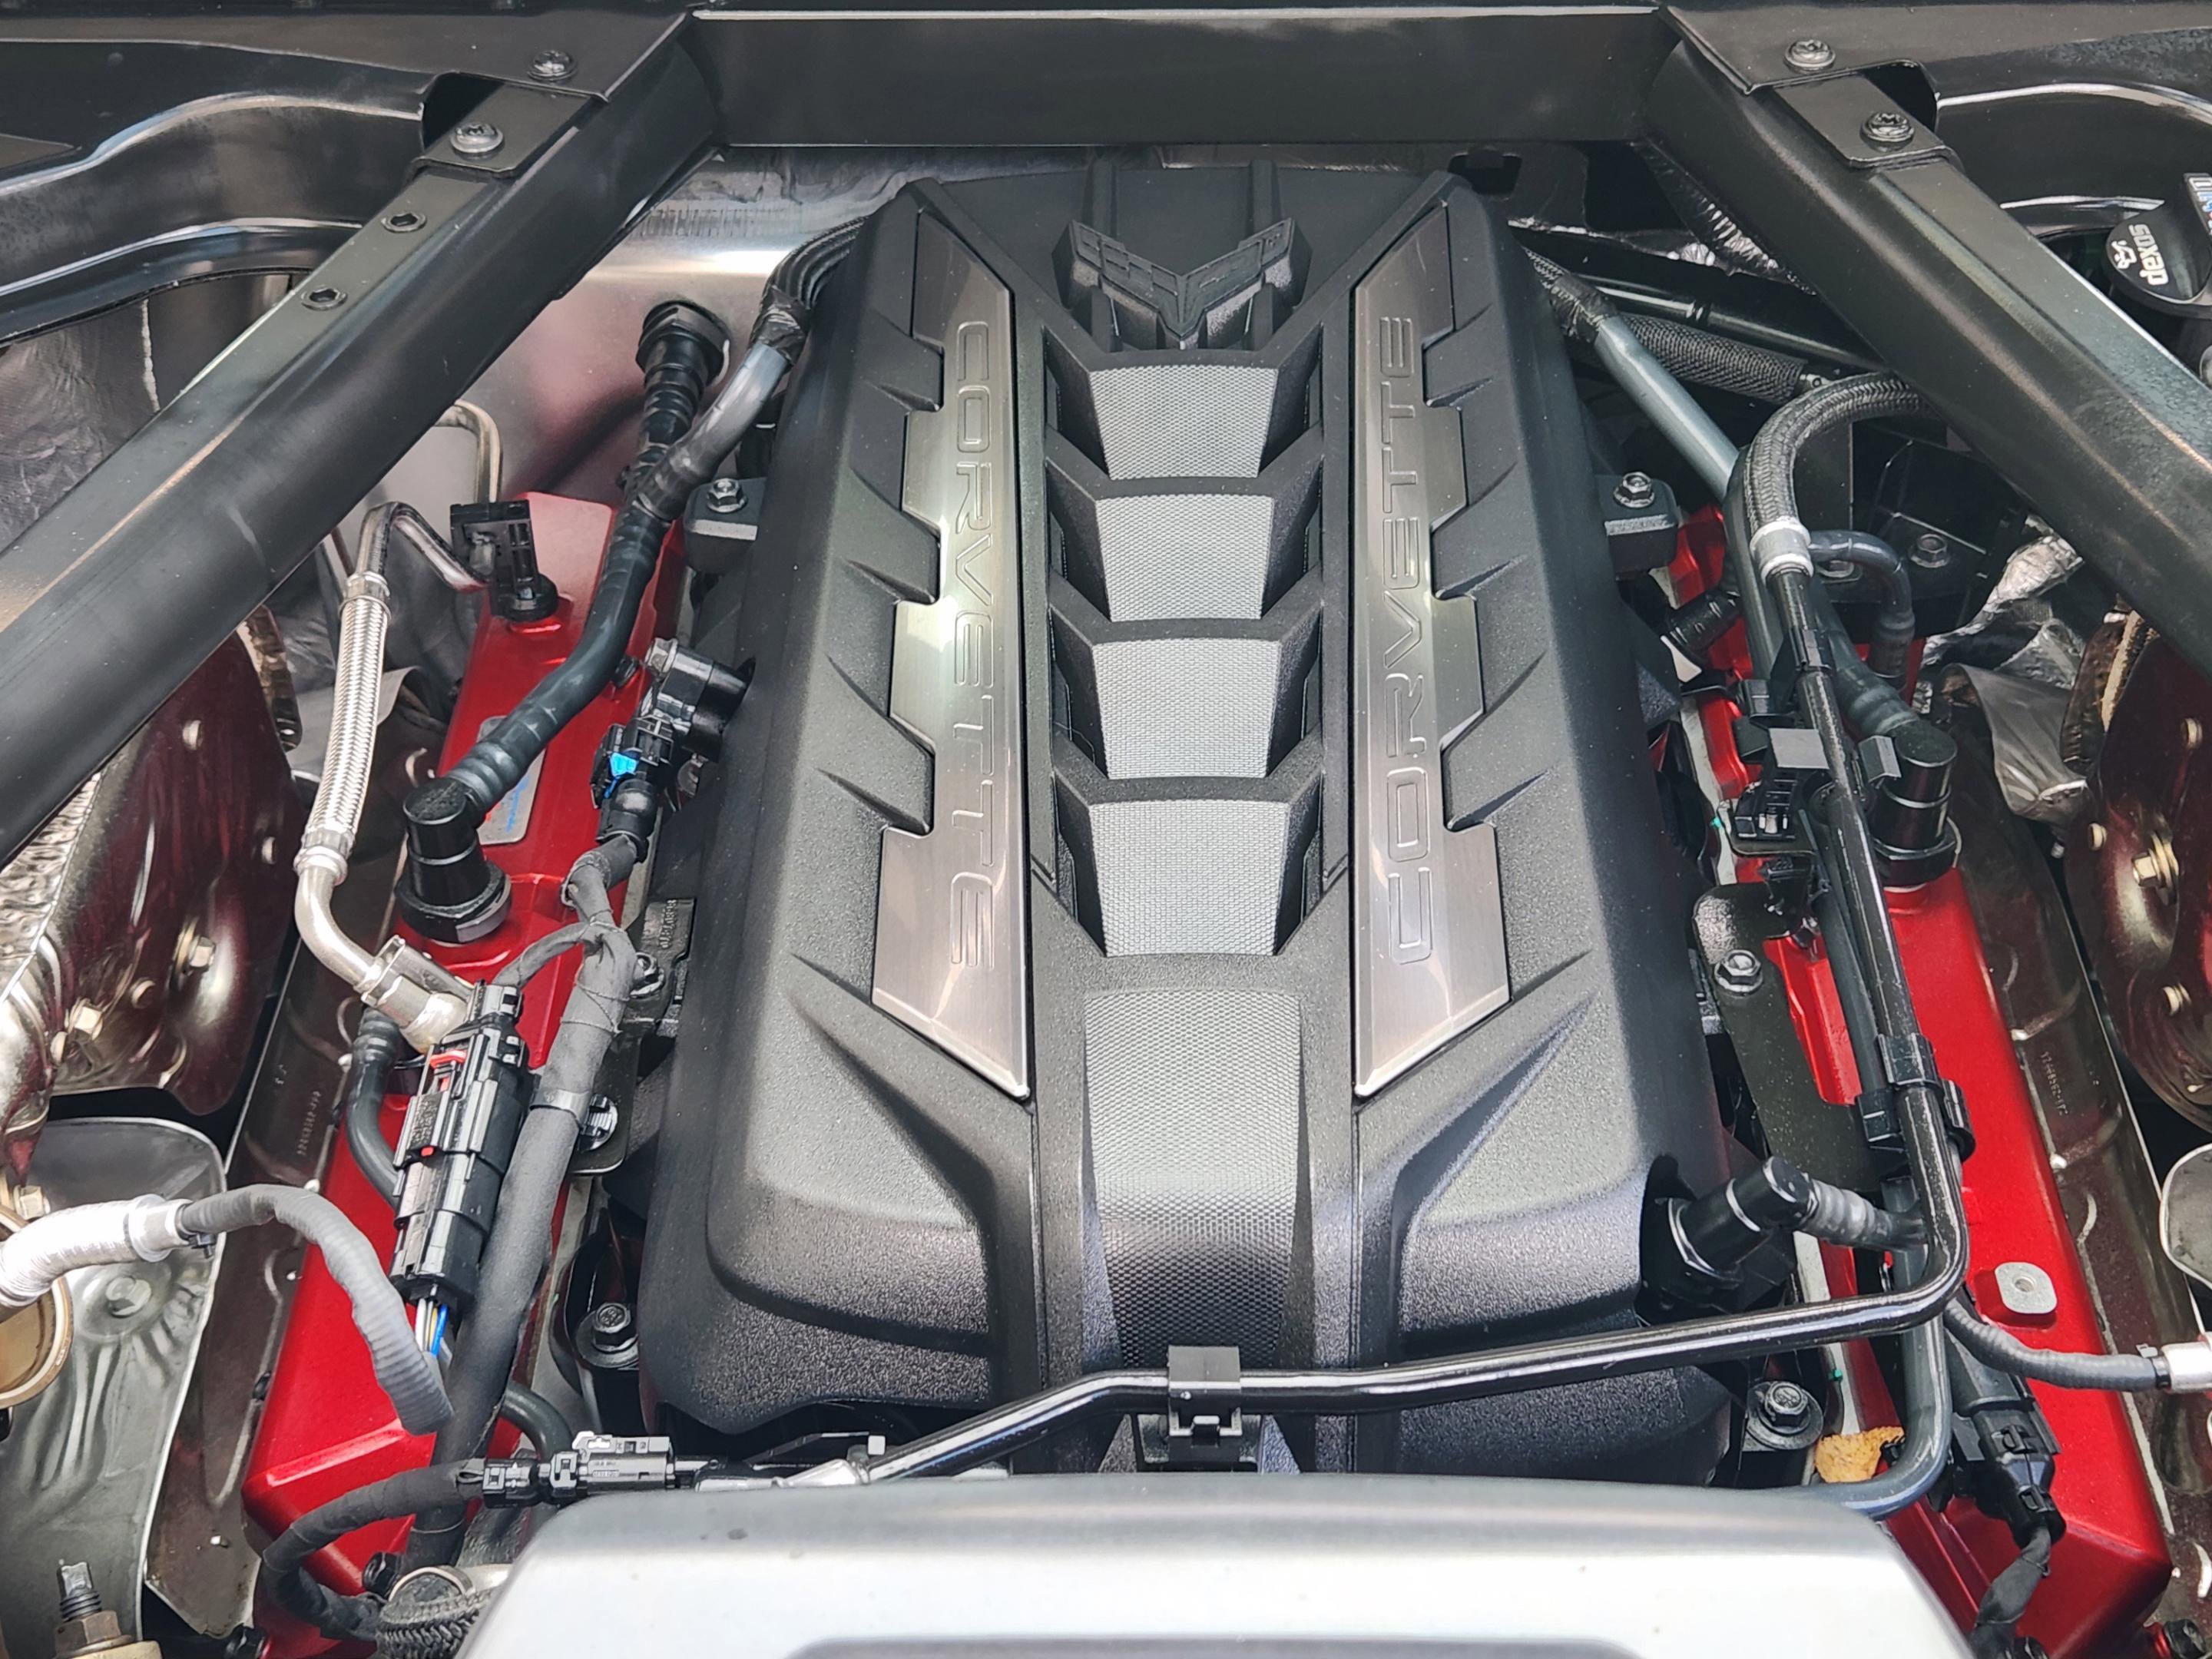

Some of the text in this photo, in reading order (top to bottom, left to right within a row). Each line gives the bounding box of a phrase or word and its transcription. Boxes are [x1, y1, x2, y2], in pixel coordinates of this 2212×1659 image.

[2128, 224, 2169, 286] dexos
[949, 320, 995, 970] CORVETTE
[1379, 316, 1434, 965] CORVETTE
